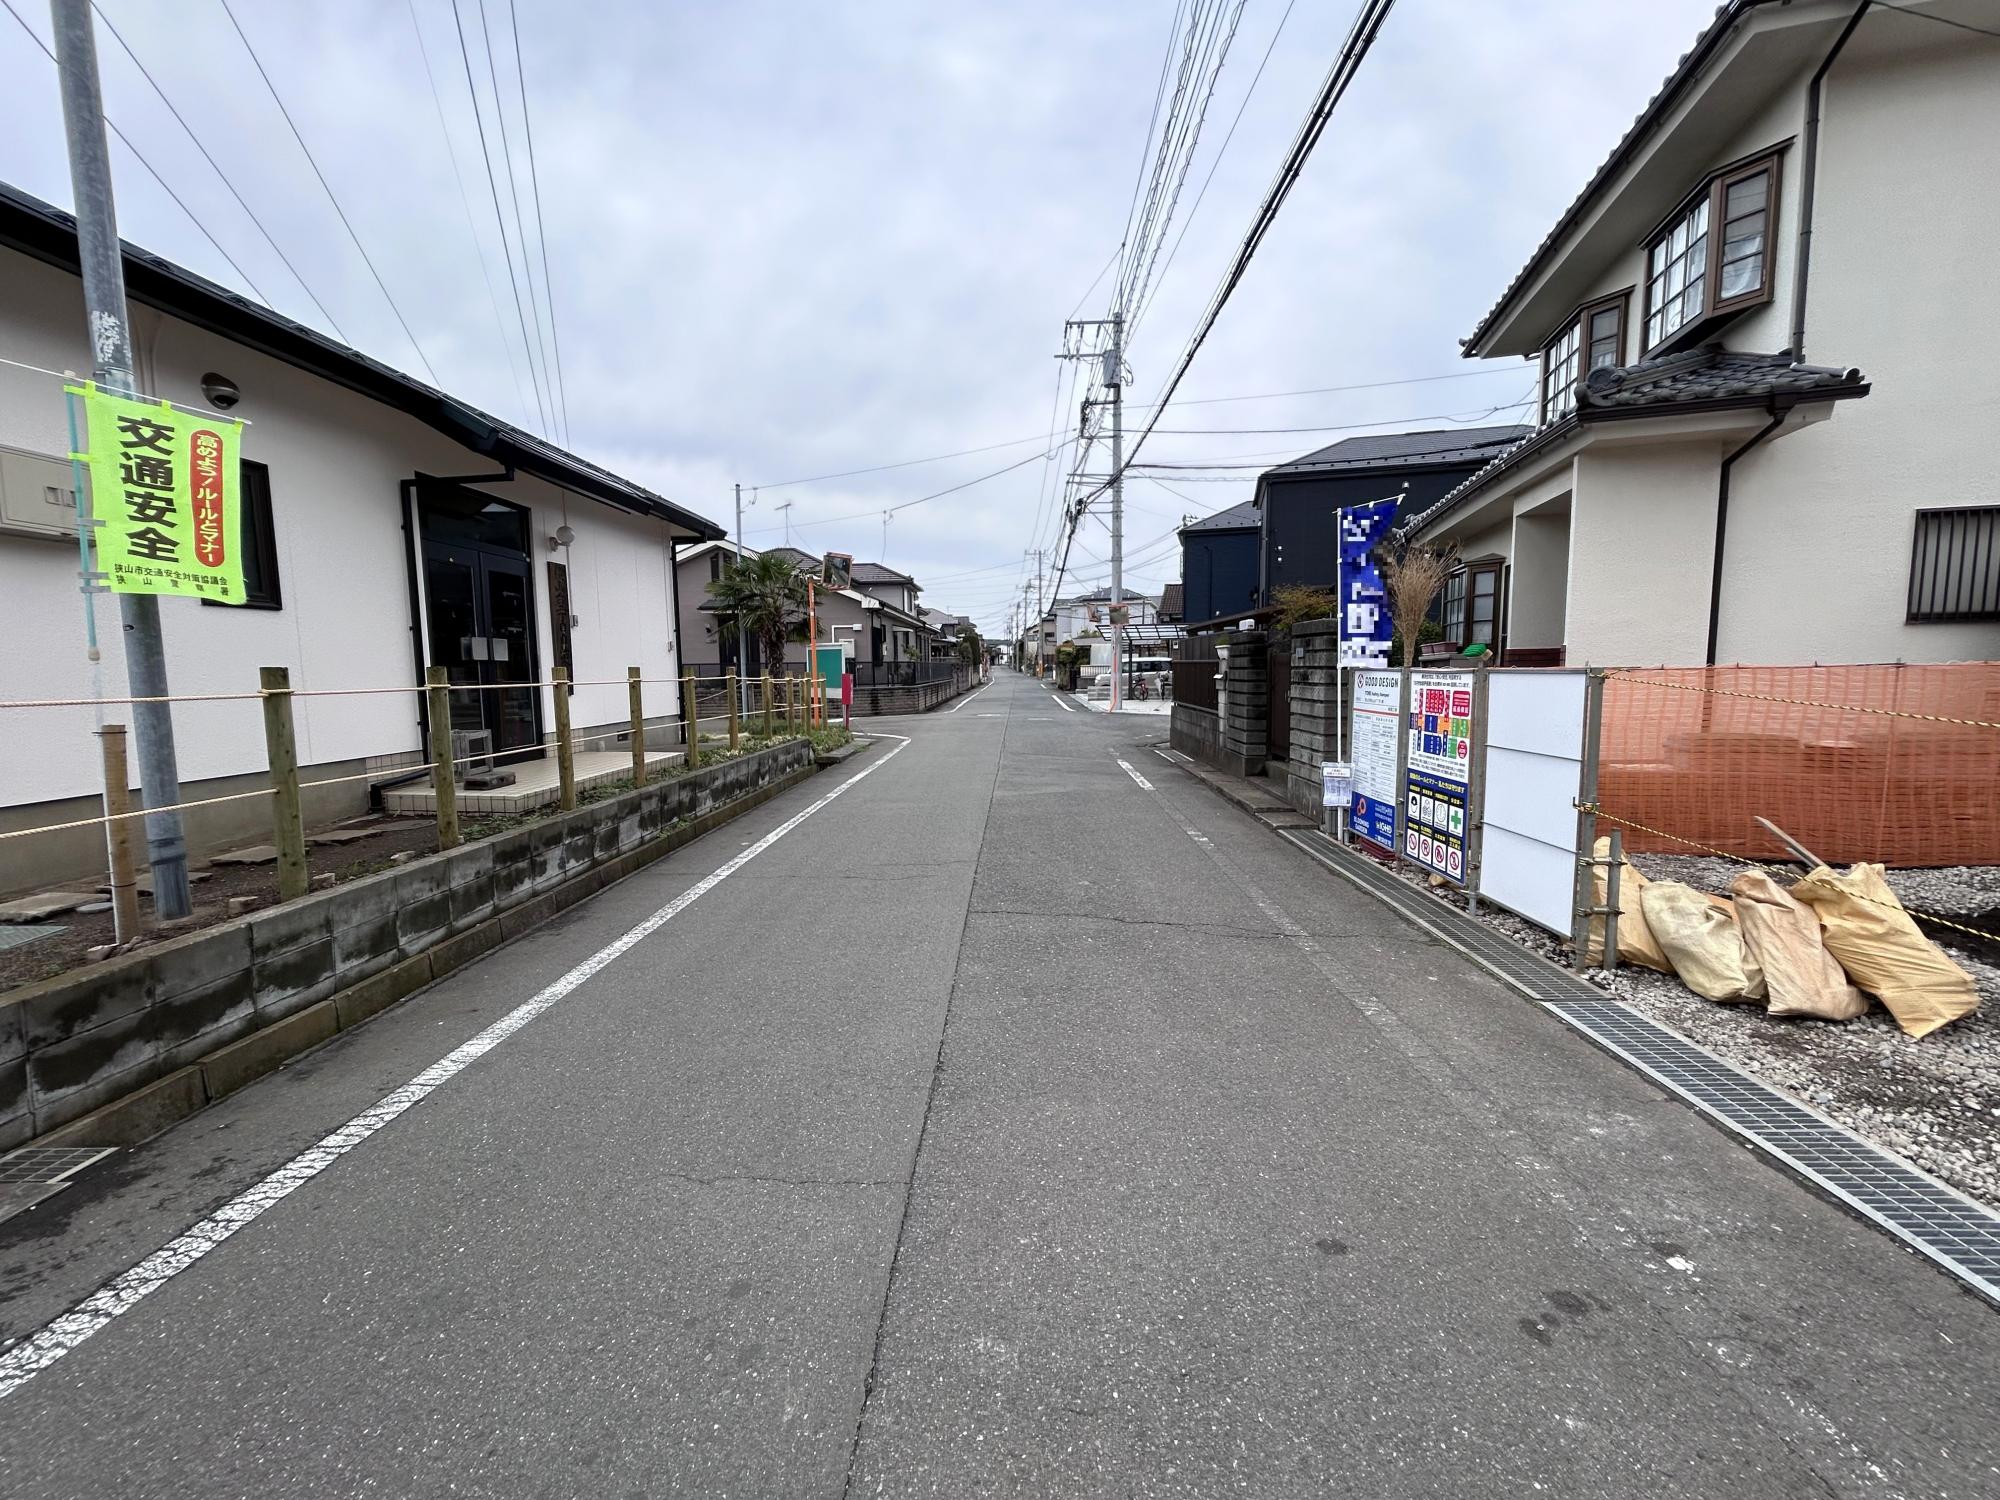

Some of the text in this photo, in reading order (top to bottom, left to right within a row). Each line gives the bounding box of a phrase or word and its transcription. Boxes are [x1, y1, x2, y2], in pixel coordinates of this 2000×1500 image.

[117, 415, 180, 564] 交通安全
[114, 563, 228, 586] 狭山市交通安全対策協議会
[1365, 677, 1399, 688] GOOD DESIGN
